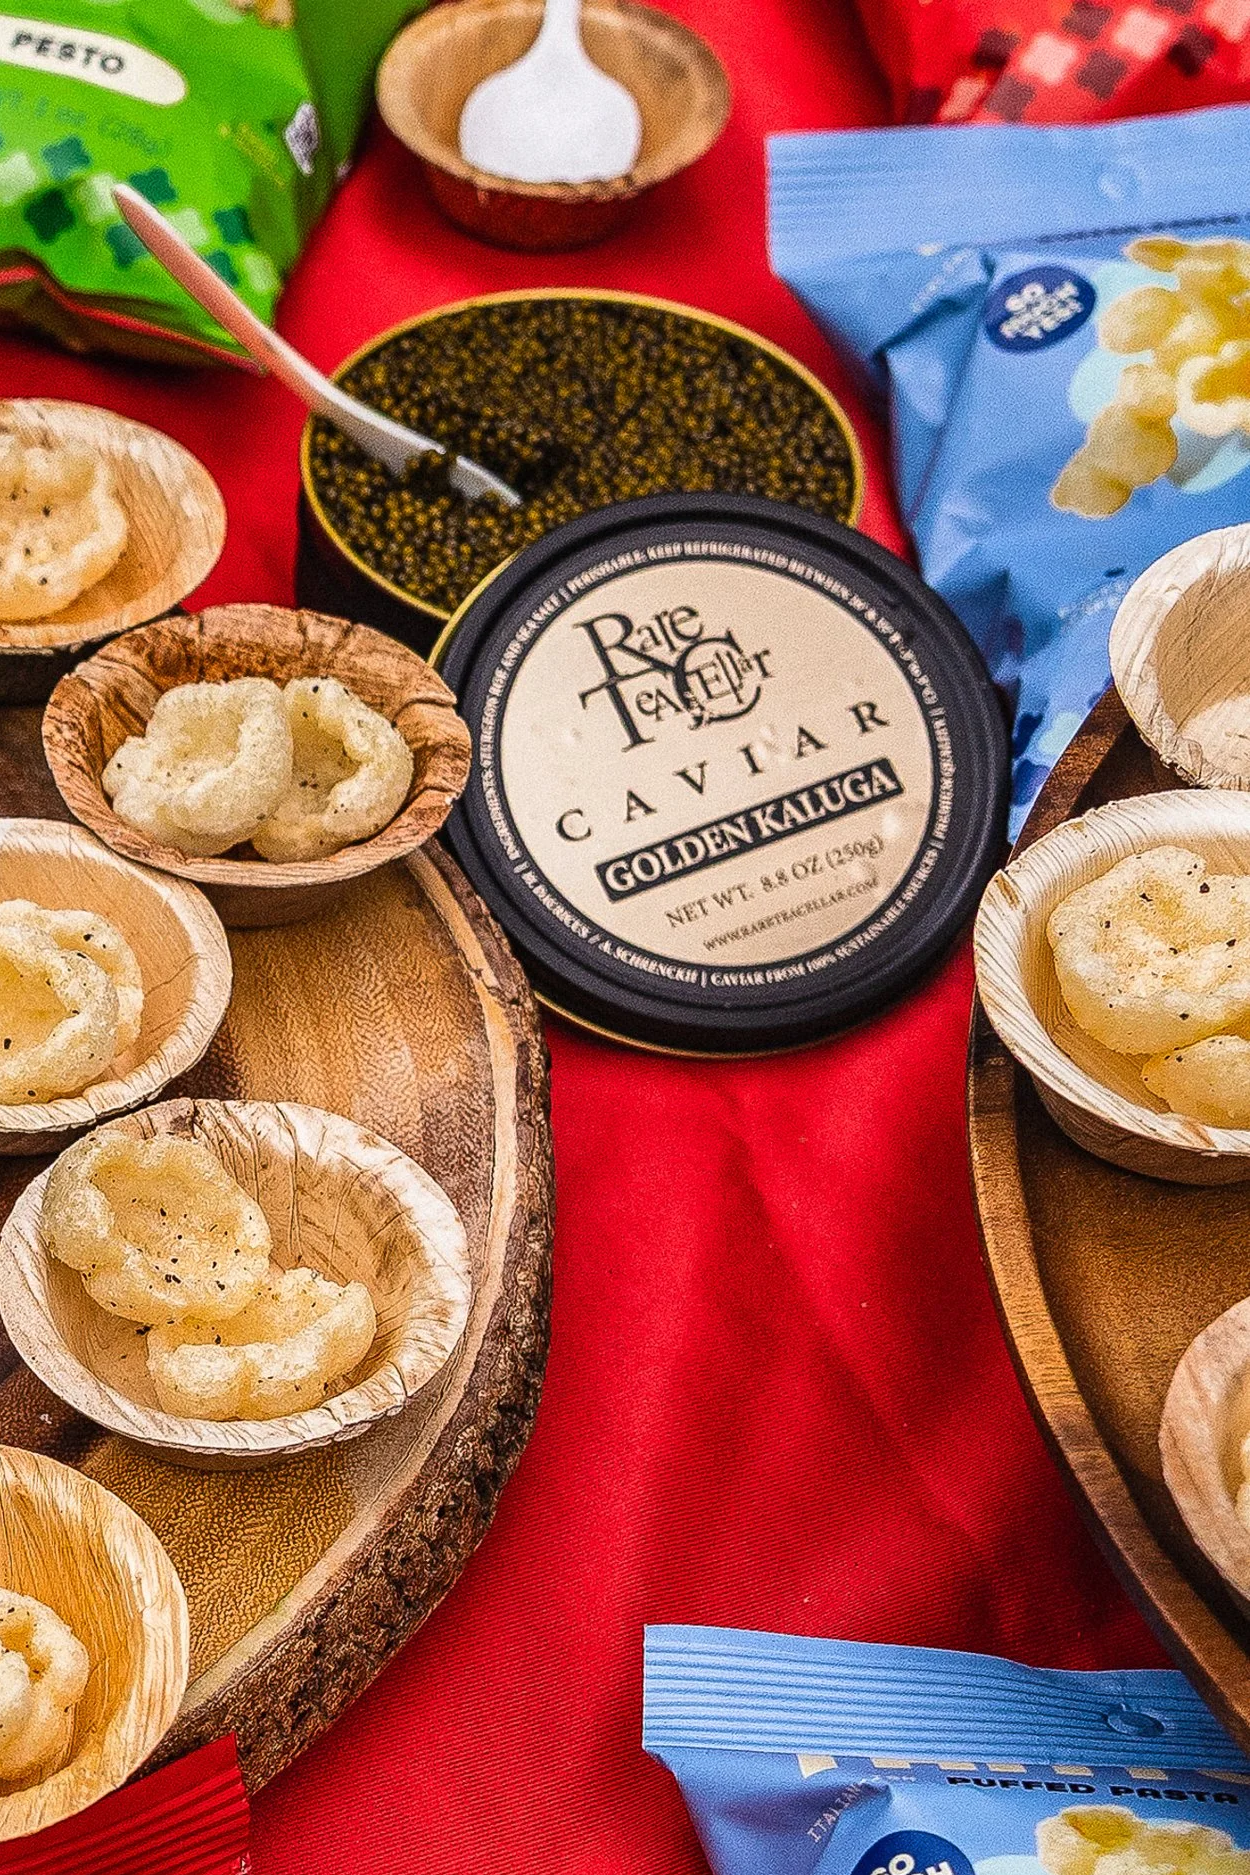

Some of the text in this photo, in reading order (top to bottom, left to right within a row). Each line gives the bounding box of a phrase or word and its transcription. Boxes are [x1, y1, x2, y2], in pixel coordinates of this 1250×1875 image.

[11, 30, 125, 74] PESTO
[573, 606, 703, 677] Rare
[555, 700, 890, 843] CAVIAR
[605, 762, 898, 892] GOLDEN KALUGA
[665, 833, 886, 928] NET WT. 8.8 OZ (250g)
[709, 970, 765, 987] CAVIAR
[947, 1776, 1240, 1804] PUFFED PASTA
